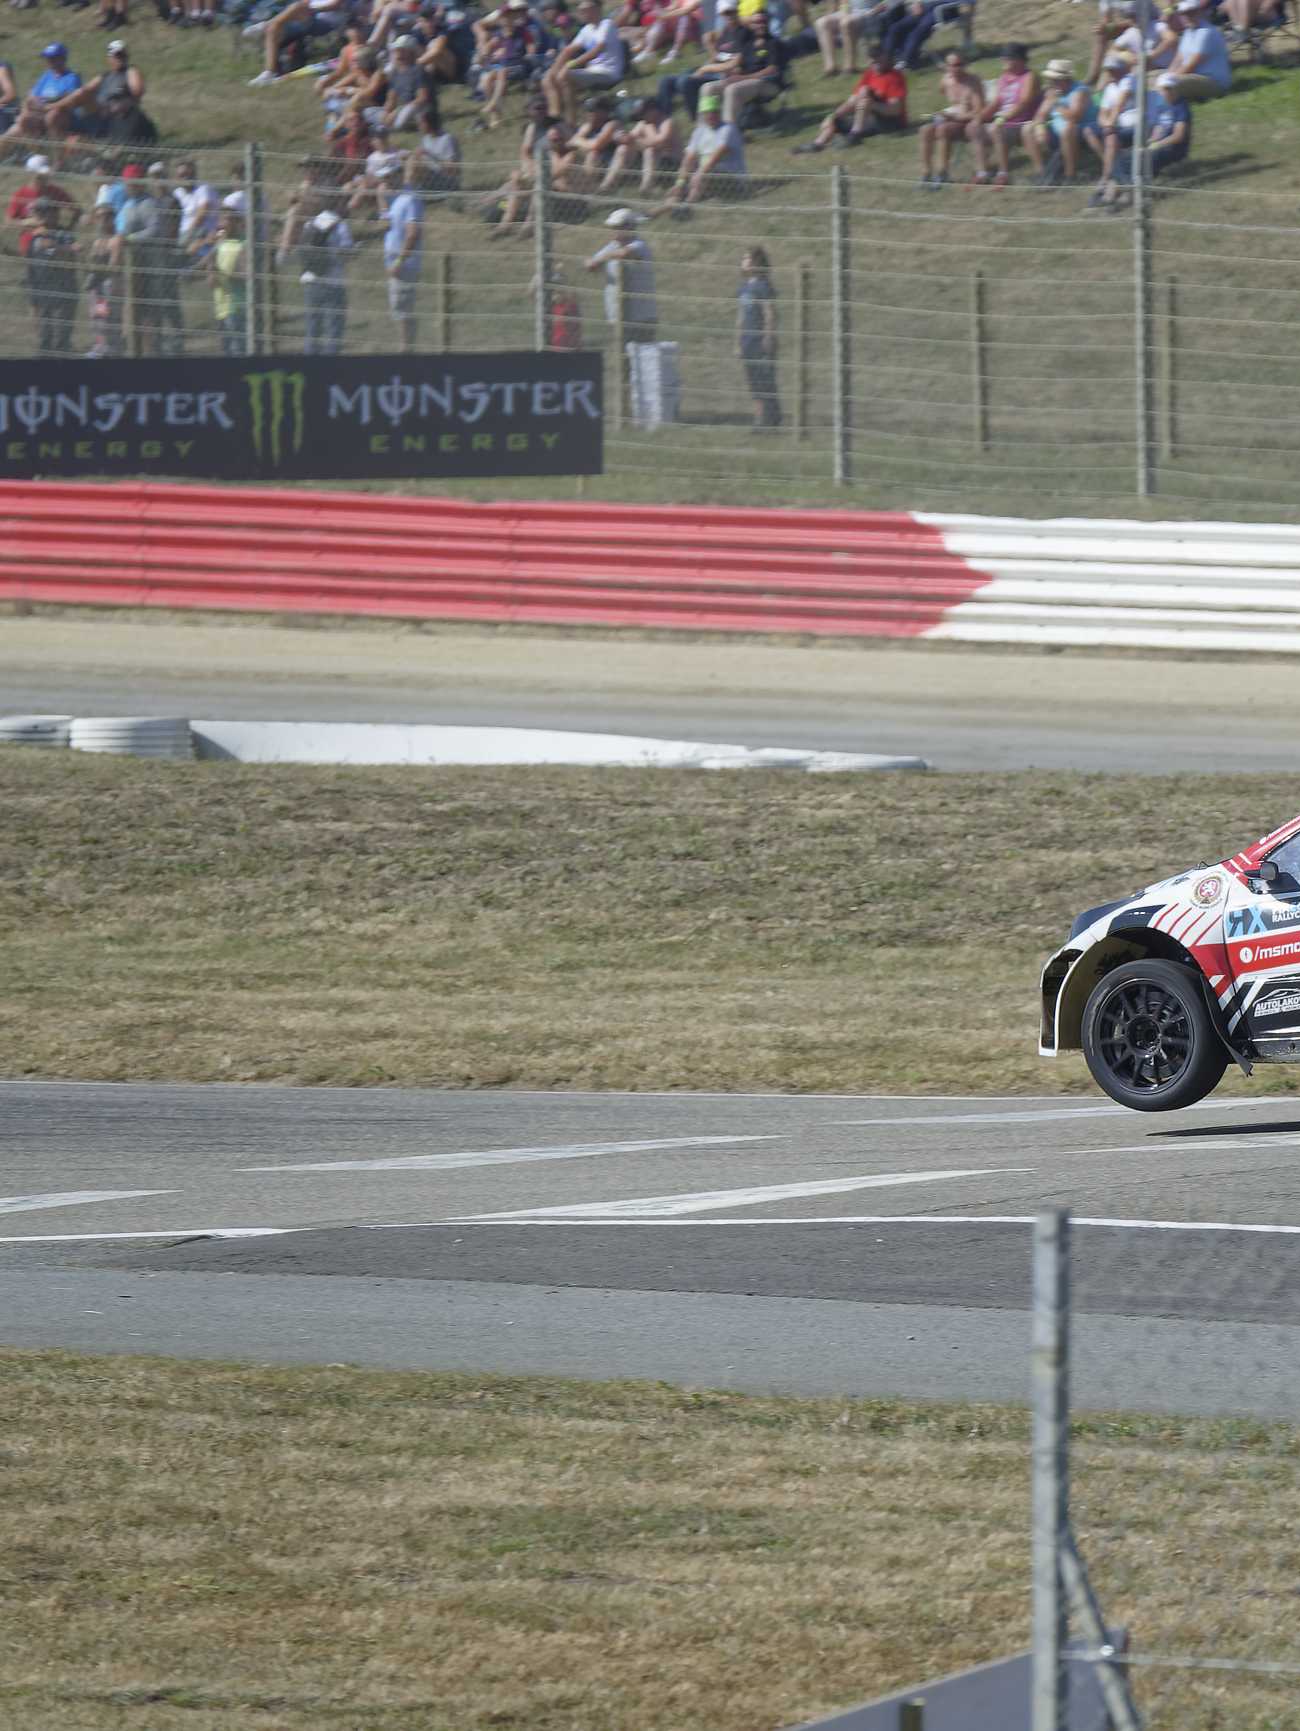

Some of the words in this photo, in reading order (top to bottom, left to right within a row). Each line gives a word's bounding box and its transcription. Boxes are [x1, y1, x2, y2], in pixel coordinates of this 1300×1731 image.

[328, 375, 602, 427] MONSTER
[7, 440, 195, 459] ENERGY
[370, 432, 561, 453] ENERGY
